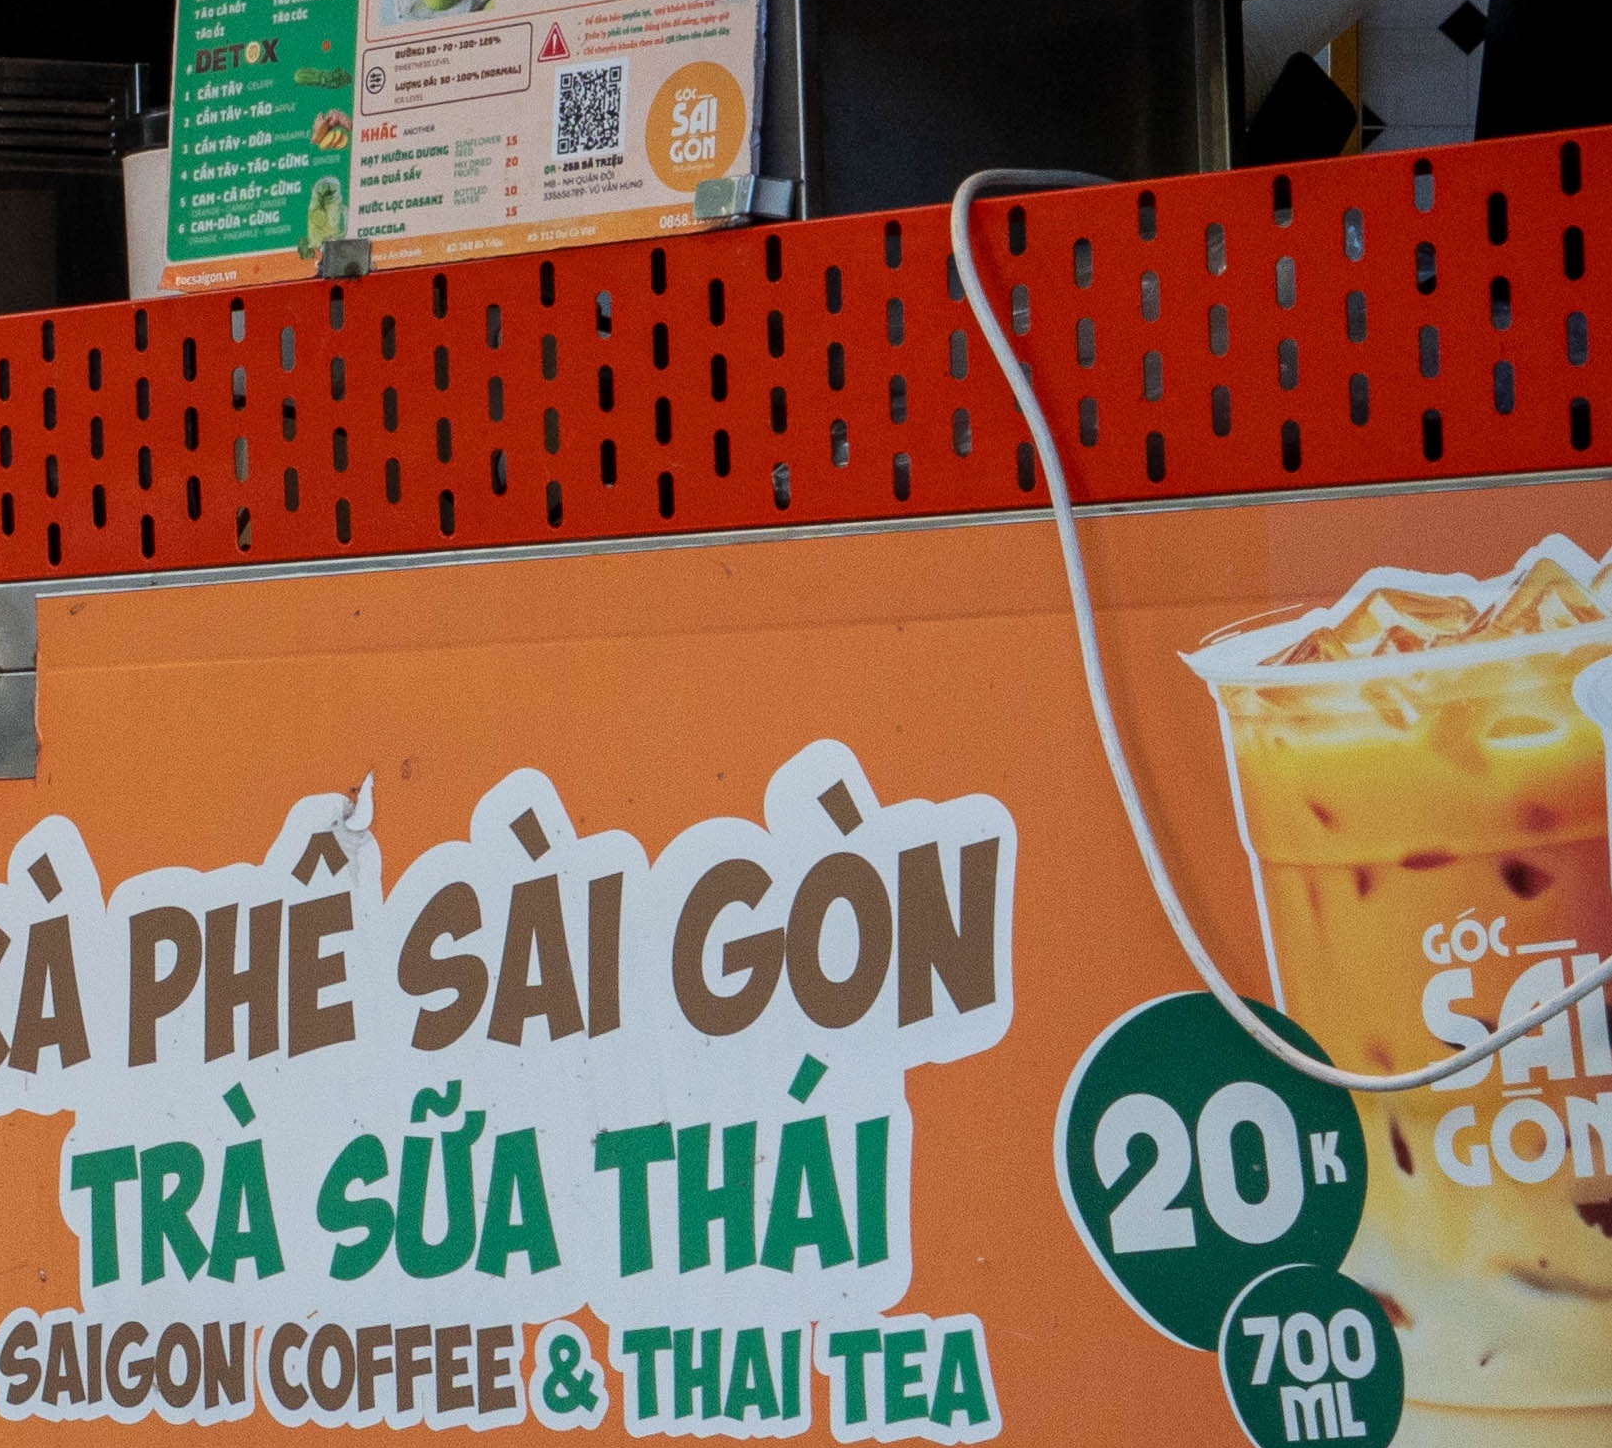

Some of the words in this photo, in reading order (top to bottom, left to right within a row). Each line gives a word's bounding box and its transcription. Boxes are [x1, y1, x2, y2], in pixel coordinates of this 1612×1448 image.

[196, 38, 279, 74] DETOX
[360, 122, 397, 143] KHÁC
[403, 124, 435, 136] ANOTHER
[360, 176, 380, 187] HOA
[505, 156, 518, 167] 20
[357, 223, 406, 237] COCACOLA
[128, 830, 357, 1068] PHÊ
[396, 806, 624, 1052] SÀI
[671, 778, 1000, 1037] GÒN
[1422, 908, 1510, 964] GÓC
[70, 1081, 285, 1288] TRÀ
[315, 1078, 562, 1281] SỮA
[593, 1052, 890, 1279] THÁI
[269, 1320, 517, 1415] COFFEE
[542, 1333, 600, 1414] &
[622, 1326, 803, 1422] THAI
[830, 1328, 991, 1428] TEA
[1242, 1307, 1377, 1387] 700
[1279, 1381, 1367, 1442] ML
